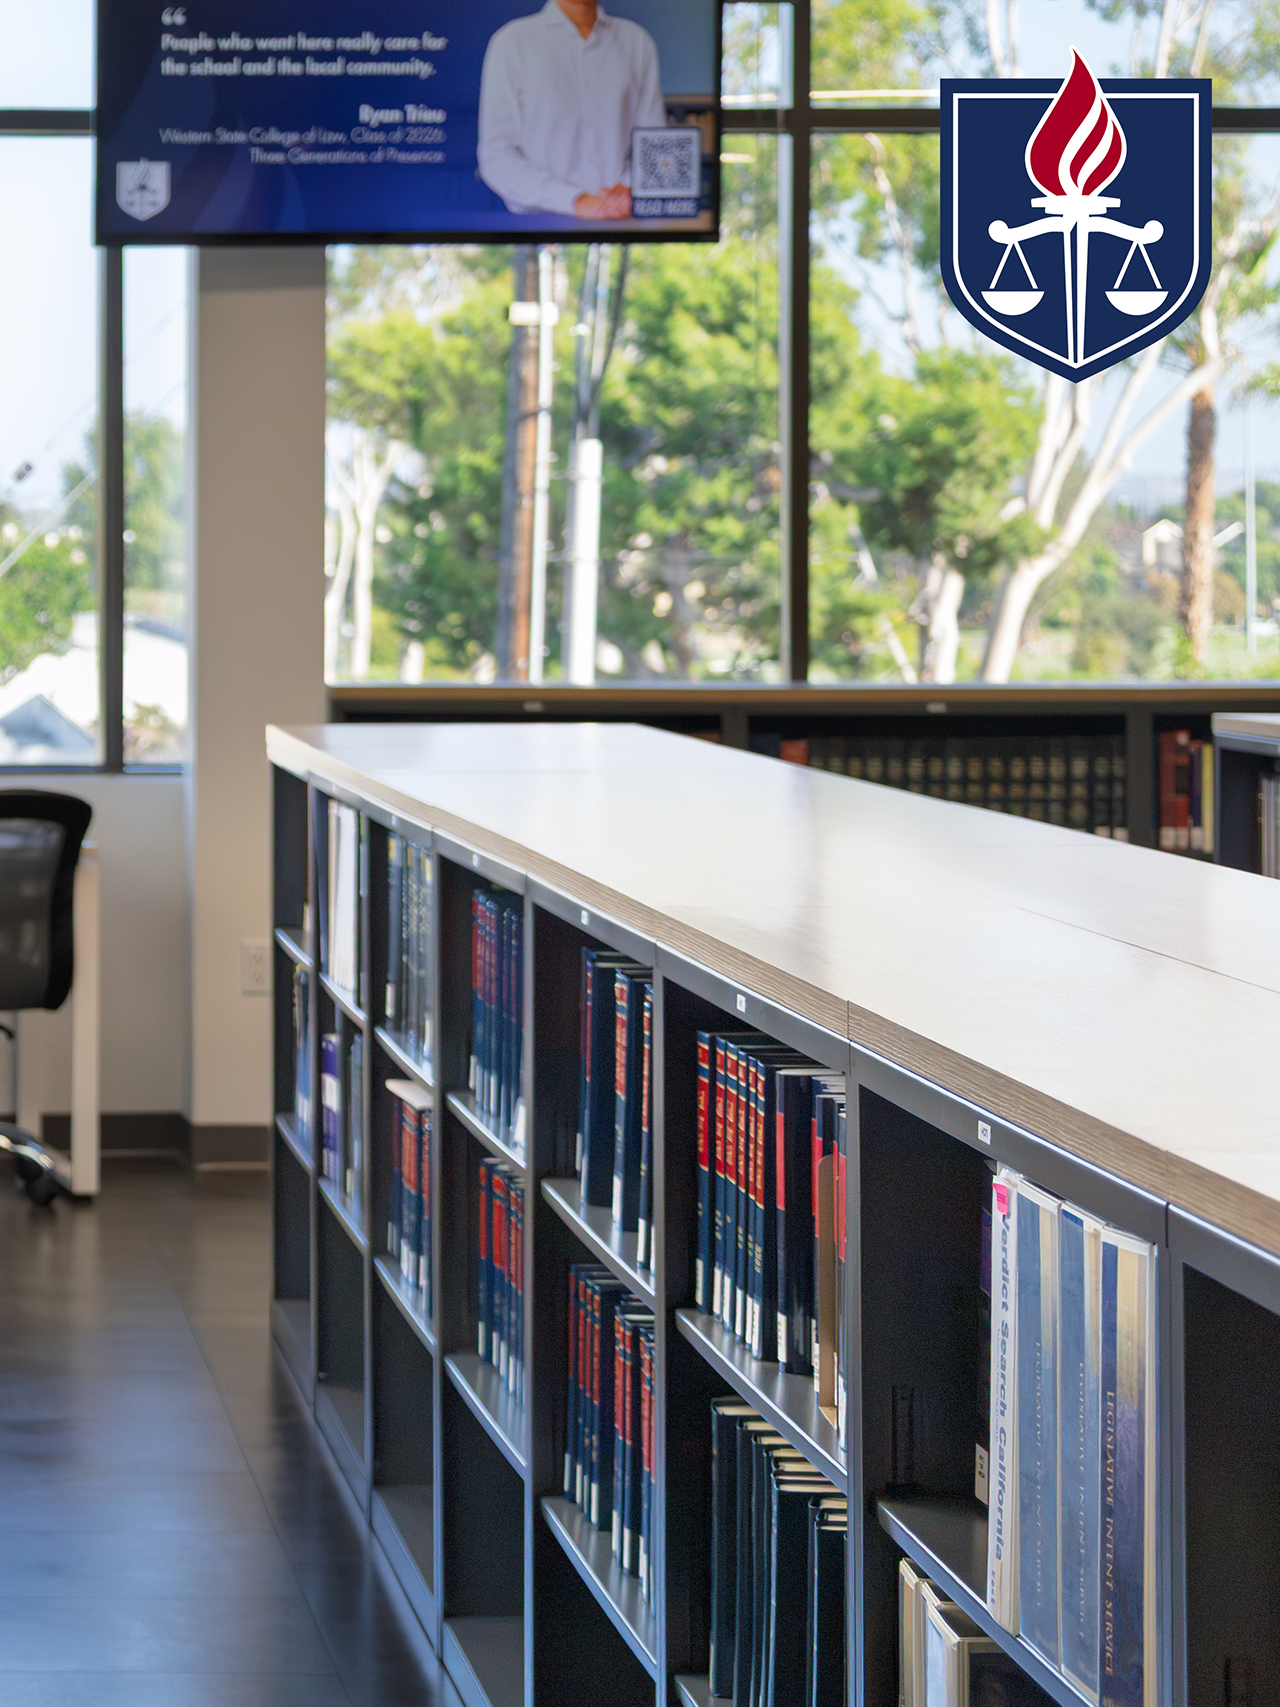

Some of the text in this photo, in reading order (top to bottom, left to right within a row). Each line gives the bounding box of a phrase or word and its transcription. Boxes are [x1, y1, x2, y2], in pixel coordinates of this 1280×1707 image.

[161, 31, 217, 56] People
[217, 31, 255, 51] who
[297, 31, 335, 51] here
[336, 31, 384, 55] really
[384, 37, 420, 51] care
[422, 30, 449, 51] for
[161, 56, 437, 81] the school and the local community.
[358, 103, 405, 128] Ryan
[159, 127, 216, 145] Western
[215, 126, 249, 145] State
[248, 126, 302, 148] College
[301, 125, 318, 144] of
[350, 126, 388, 144] Class
[387, 125, 405, 144] of
[369, 145, 387, 164] of
[1001, 1211, 1012, 1312] Verdict
[994, 1426, 1008, 1561] California
